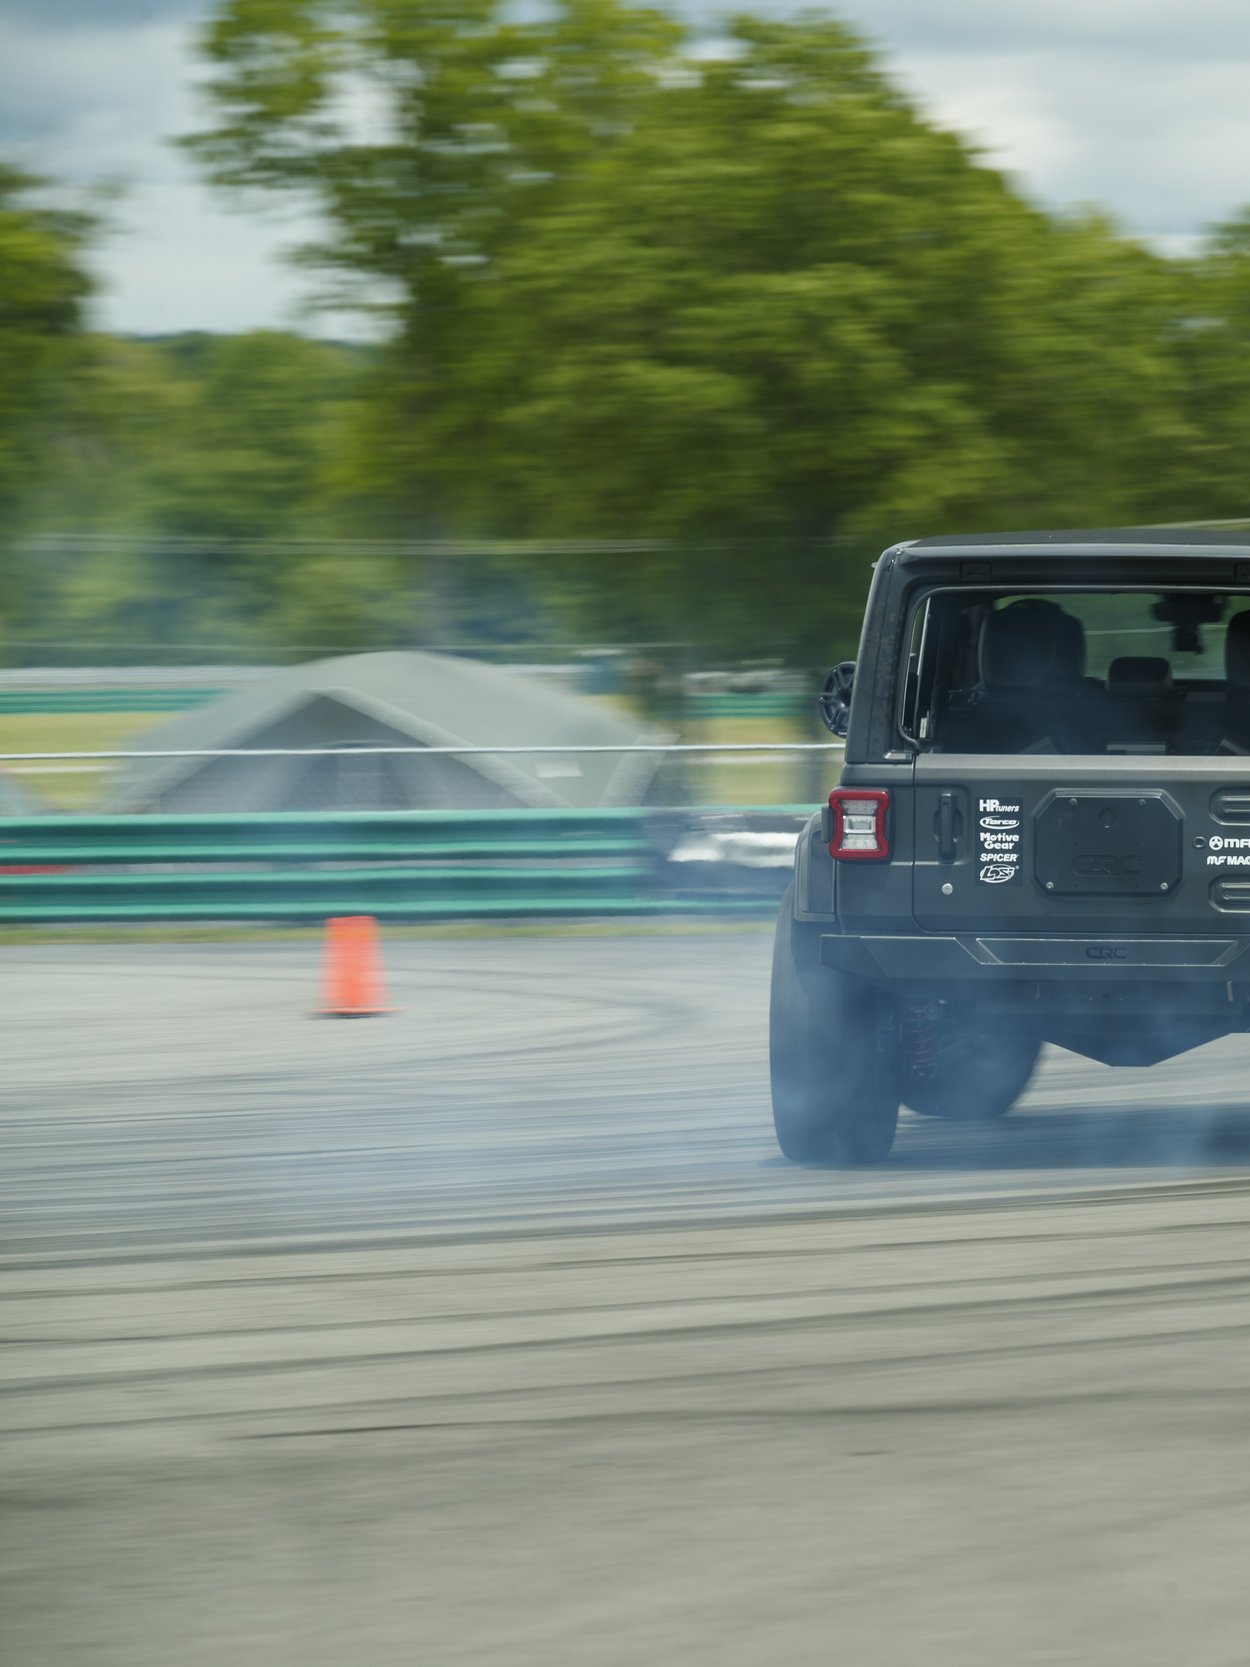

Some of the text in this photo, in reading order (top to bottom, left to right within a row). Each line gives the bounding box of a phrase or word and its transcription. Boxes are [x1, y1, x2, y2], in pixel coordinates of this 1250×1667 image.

[980, 832, 1019, 841] Motive
[984, 841, 1014, 850] Gear
[980, 853, 1017, 862] SPICER
